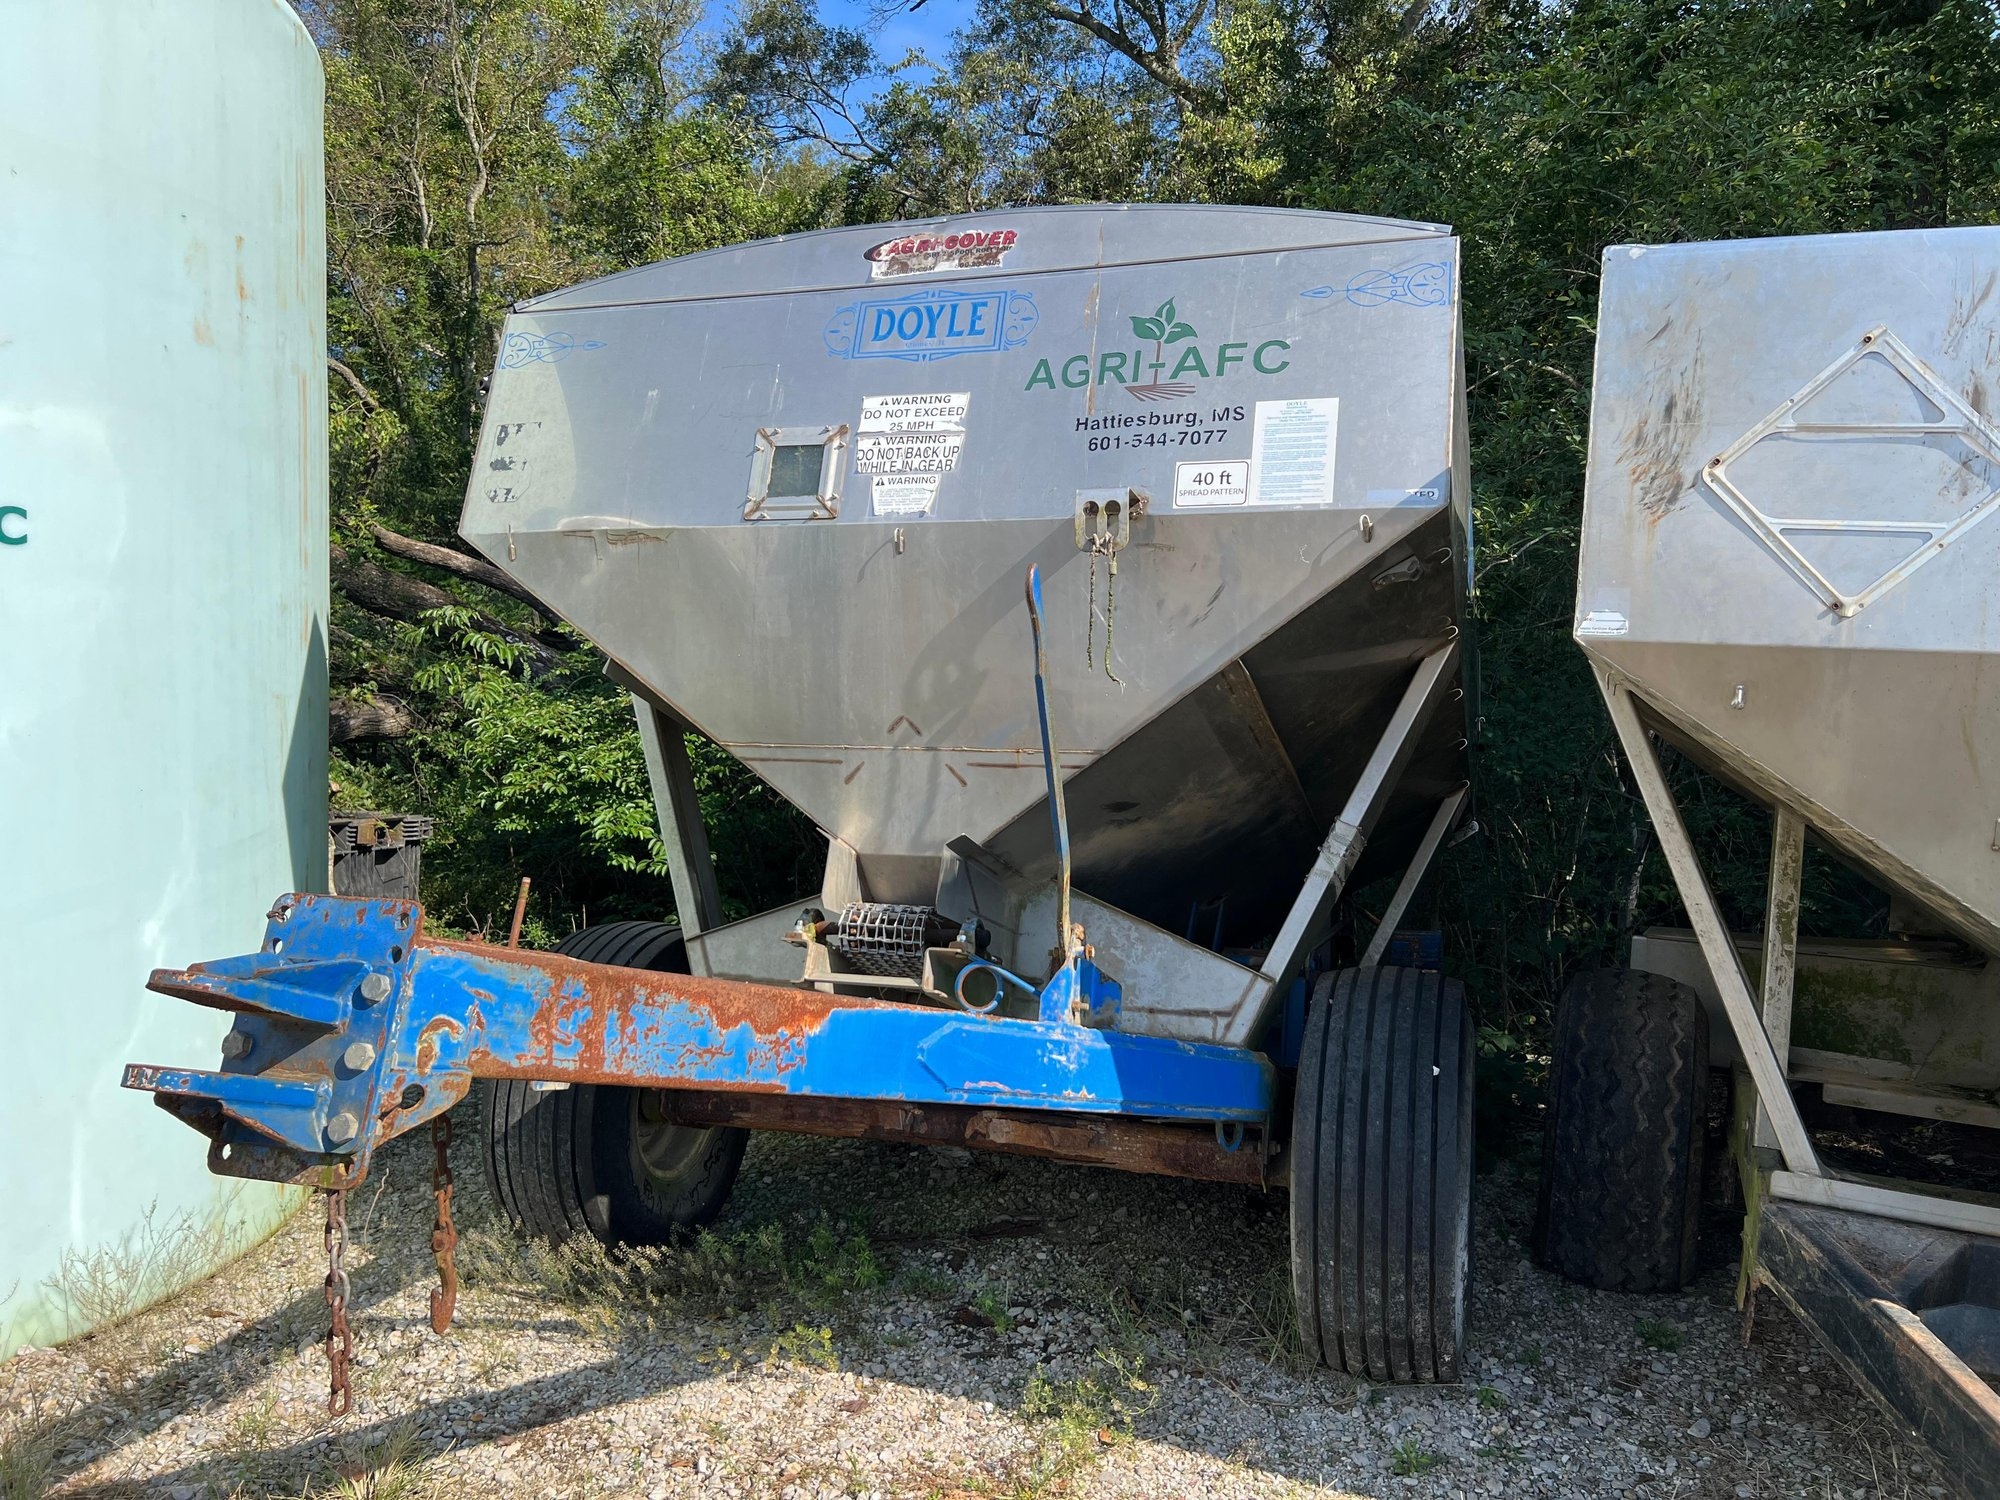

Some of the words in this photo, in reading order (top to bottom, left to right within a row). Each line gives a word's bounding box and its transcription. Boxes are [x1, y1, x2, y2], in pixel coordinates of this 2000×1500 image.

[886, 230, 1017, 256] AGRI-COVER
[871, 301, 988, 342] DOYLE
[1024, 340, 1291, 391] AGRI-AFC
[891, 395, 952, 406] WARNING
[864, 410, 882, 420] DO
[886, 409, 911, 419] NOT
[914, 407, 965, 417] EXCEED
[1074, 411, 1204, 432] Hattiesburg,
[1212, 406, 1246, 422] MS
[890, 422, 903, 431] 25
[907, 421, 935, 430] MPH
[886, 434, 947, 445] WARNING
[1088, 429, 1228, 451] 601-544-7077
[857, 449, 875, 461] DO
[877, 448, 903, 460] NOT
[905, 446, 940, 459] BACK
[942, 446, 960, 459] UP
[859, 461, 898, 474] WHILE
[902, 460, 914, 472] IN
[918, 459, 953, 472] GEAR
[887, 475, 937, 485] WARNING
[1192, 472, 1215, 486] 40
[1219, 470, 1232, 485] ft
[1179, 489, 1209, 497] SPREAD
[1211, 487, 1244, 496] PATTERN
